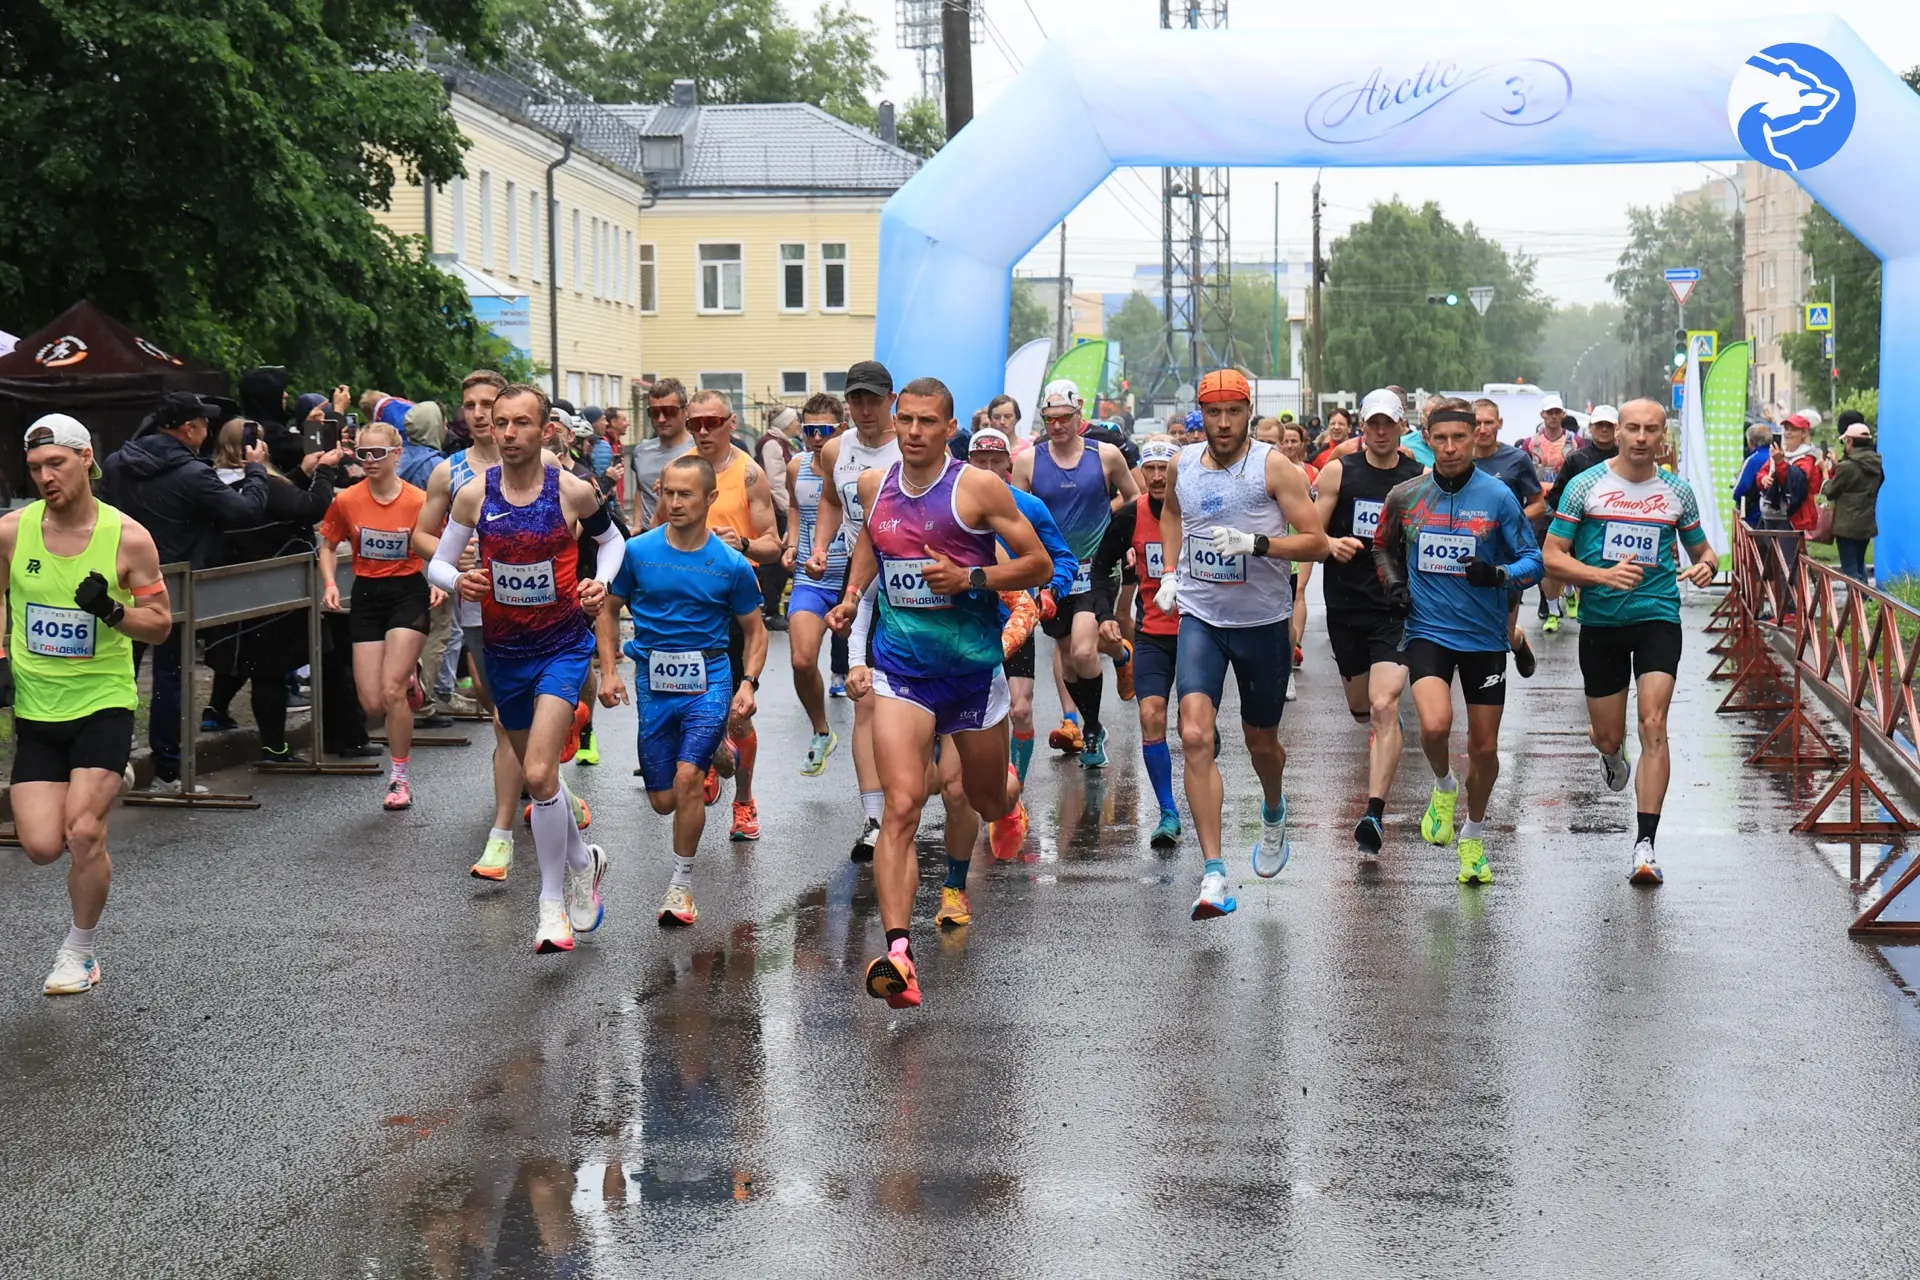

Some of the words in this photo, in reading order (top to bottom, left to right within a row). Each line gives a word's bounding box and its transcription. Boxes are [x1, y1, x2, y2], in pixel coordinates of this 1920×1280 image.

[1322, 60, 1463, 128] Arctic
[1358, 512, 1380, 524] 40
[365, 538, 404, 550] 4037
[1611, 533, 1653, 550] 4018
[1195, 550, 1236, 566] 4012
[1423, 545, 1470, 560] 4032
[1200, 570, 1240, 580] ГАНДВИК
[1430, 564, 1466, 572] ГАНДВИ
[497, 573, 550, 591] 4042
[889, 573, 927, 590] 407
[506, 594, 552, 604] ГАНДВИК
[902, 596, 946, 605] ГАНДВИК
[31, 619, 89, 640] 4056
[39, 642, 89, 655] ГАНДВИК
[654, 662, 701, 678] 4073
[662, 682, 702, 690] ГАНДВИК
